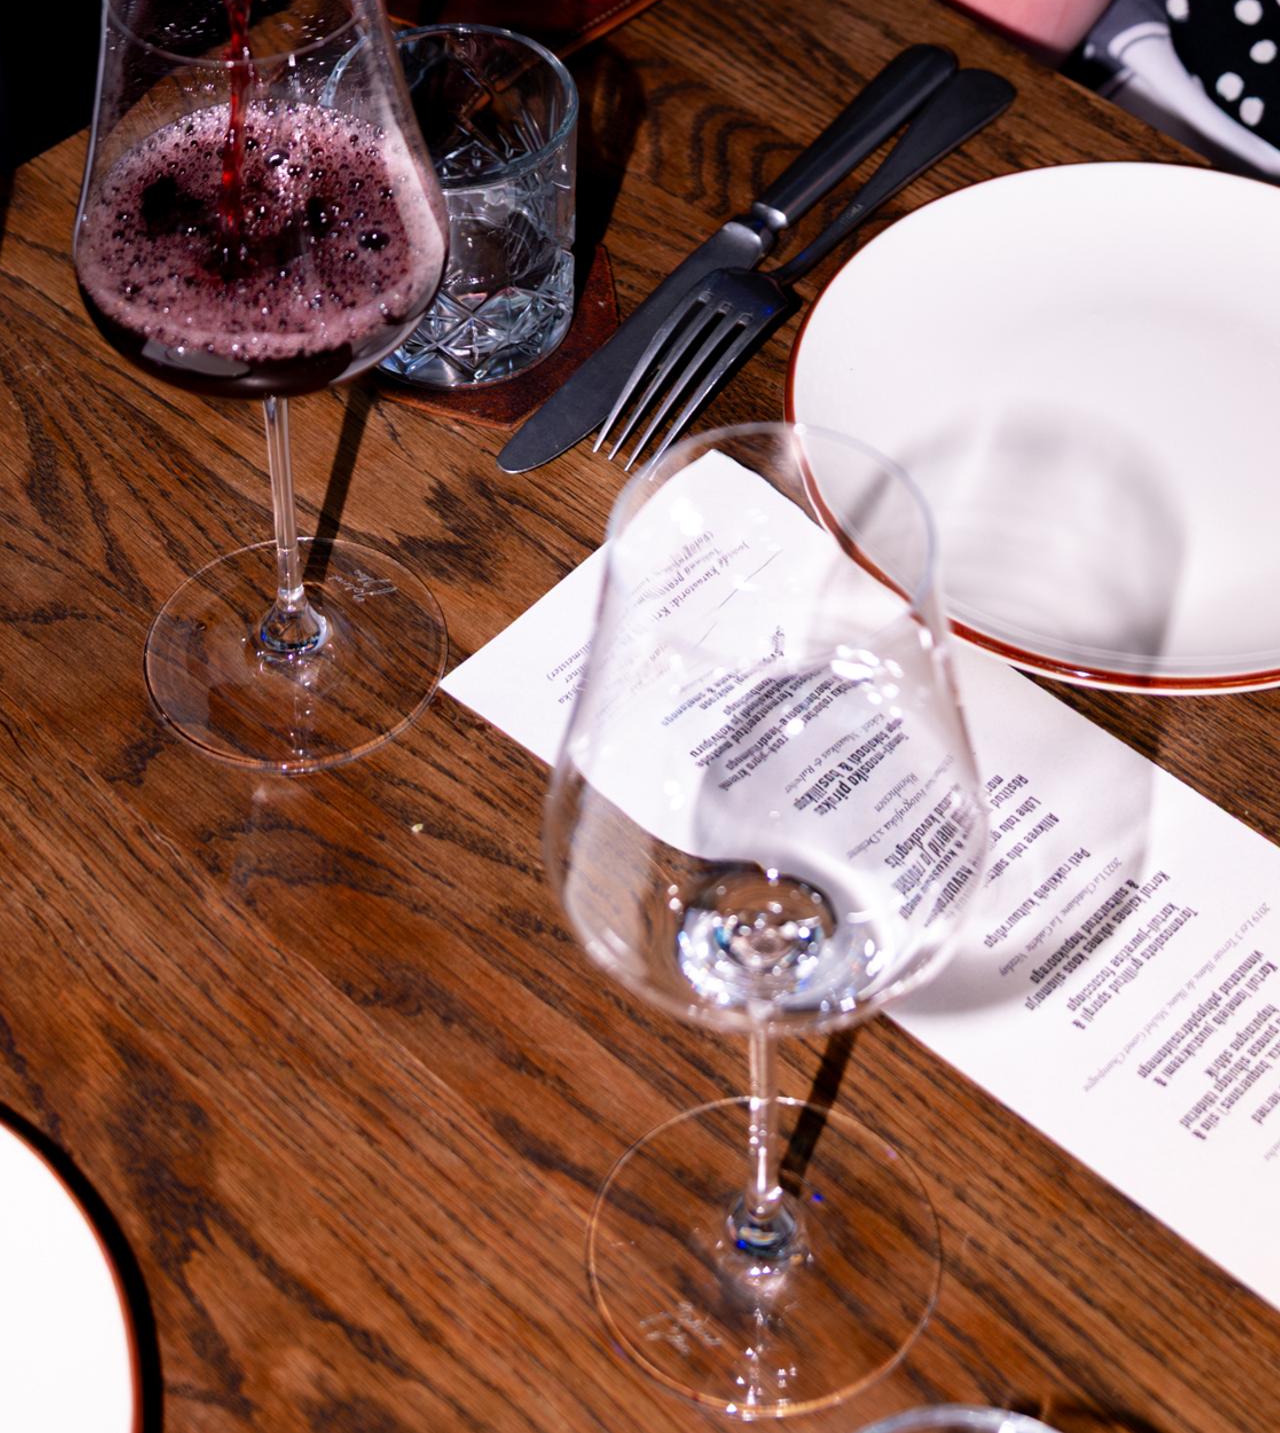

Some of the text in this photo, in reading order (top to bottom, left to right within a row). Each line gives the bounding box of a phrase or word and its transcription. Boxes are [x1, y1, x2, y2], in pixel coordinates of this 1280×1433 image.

[1068, 847, 1090, 866] Peti
[1033, 864, 1070, 898] rukkileib
[1125, 879, 1139, 889] &
[1139, 871, 1170, 898] Kartul
[1140, 907, 1197, 959] Taramasalata
[1108, 957, 1143, 993] grillitud
[1246, 961, 1277, 991] Kartuli
[1072, 1019, 1085, 1029] &
